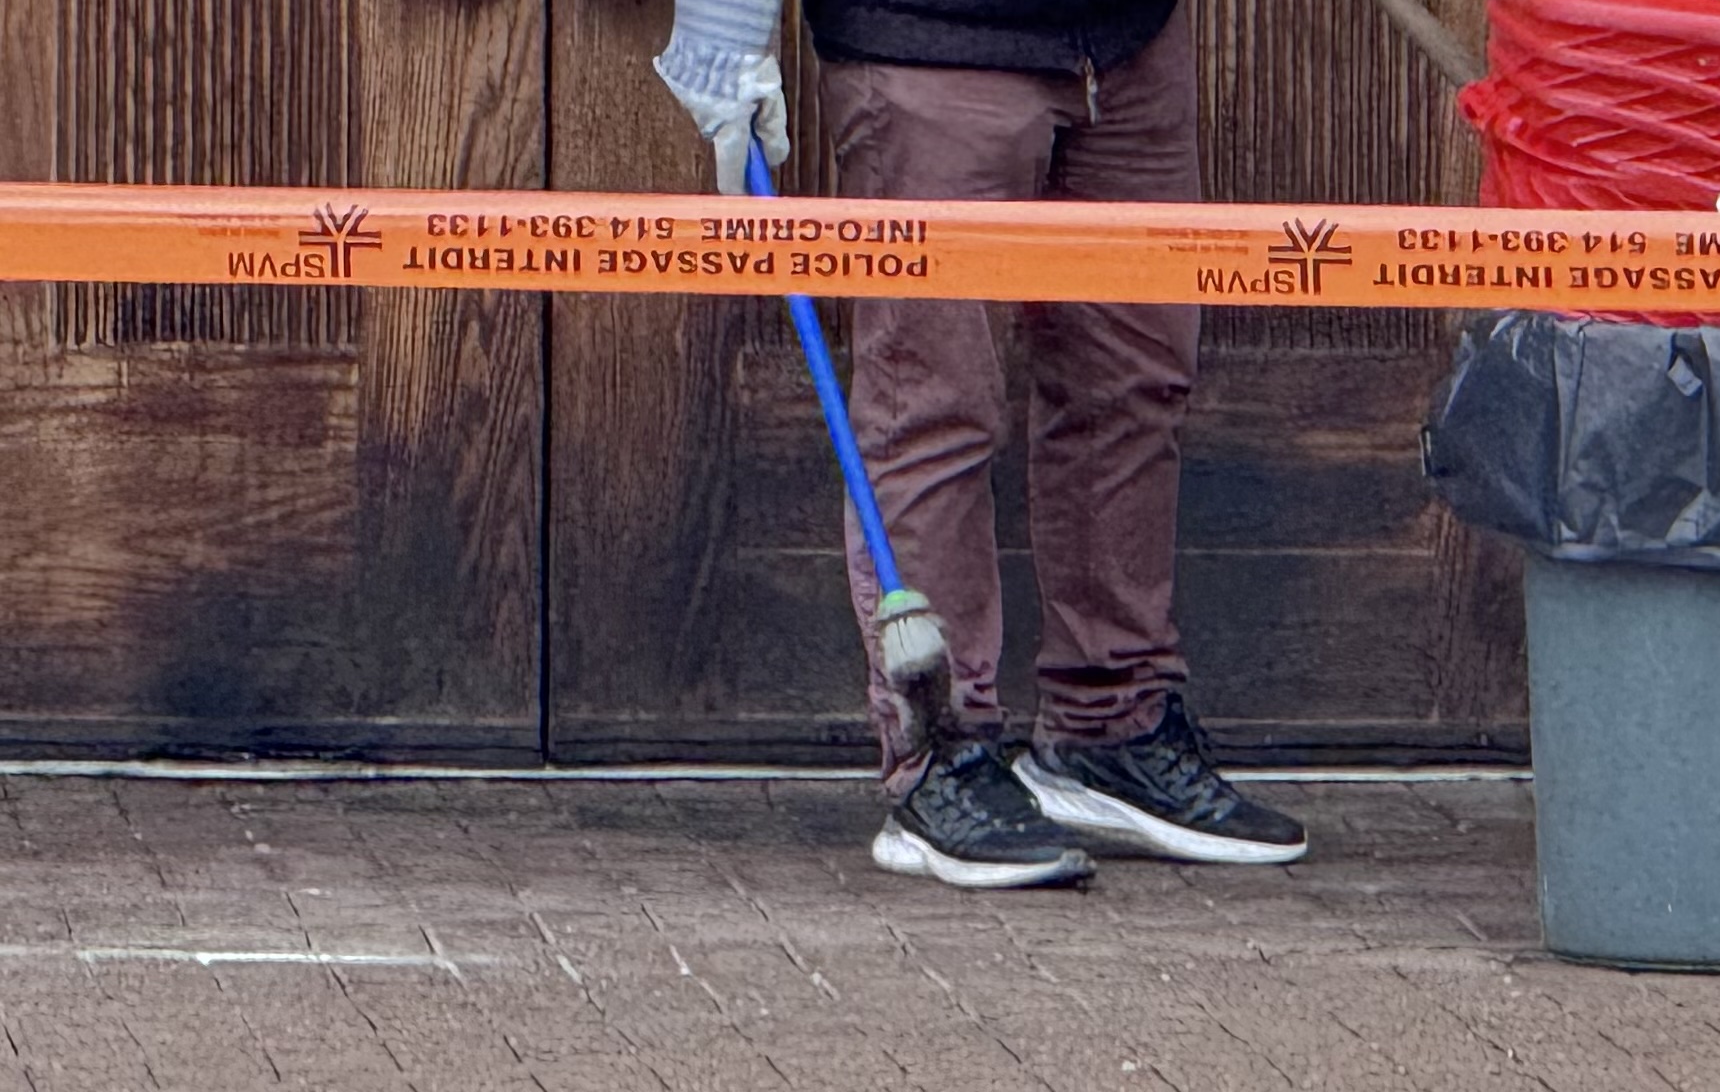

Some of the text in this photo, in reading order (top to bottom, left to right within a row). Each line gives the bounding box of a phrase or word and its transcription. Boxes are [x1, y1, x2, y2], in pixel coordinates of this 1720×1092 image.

[427, 214, 926, 243] INFO-CRIME 514 393-1133
[1398, 229, 1566, 253] 393-1133
[1582, 231, 1646, 254] 514
[228, 252, 325, 278] SPVM
[402, 246, 928, 277] POLICE PASSAGE INTERDIT
[1197, 268, 1294, 294] SPVM
[1373, 263, 1553, 287] INTERDIT
